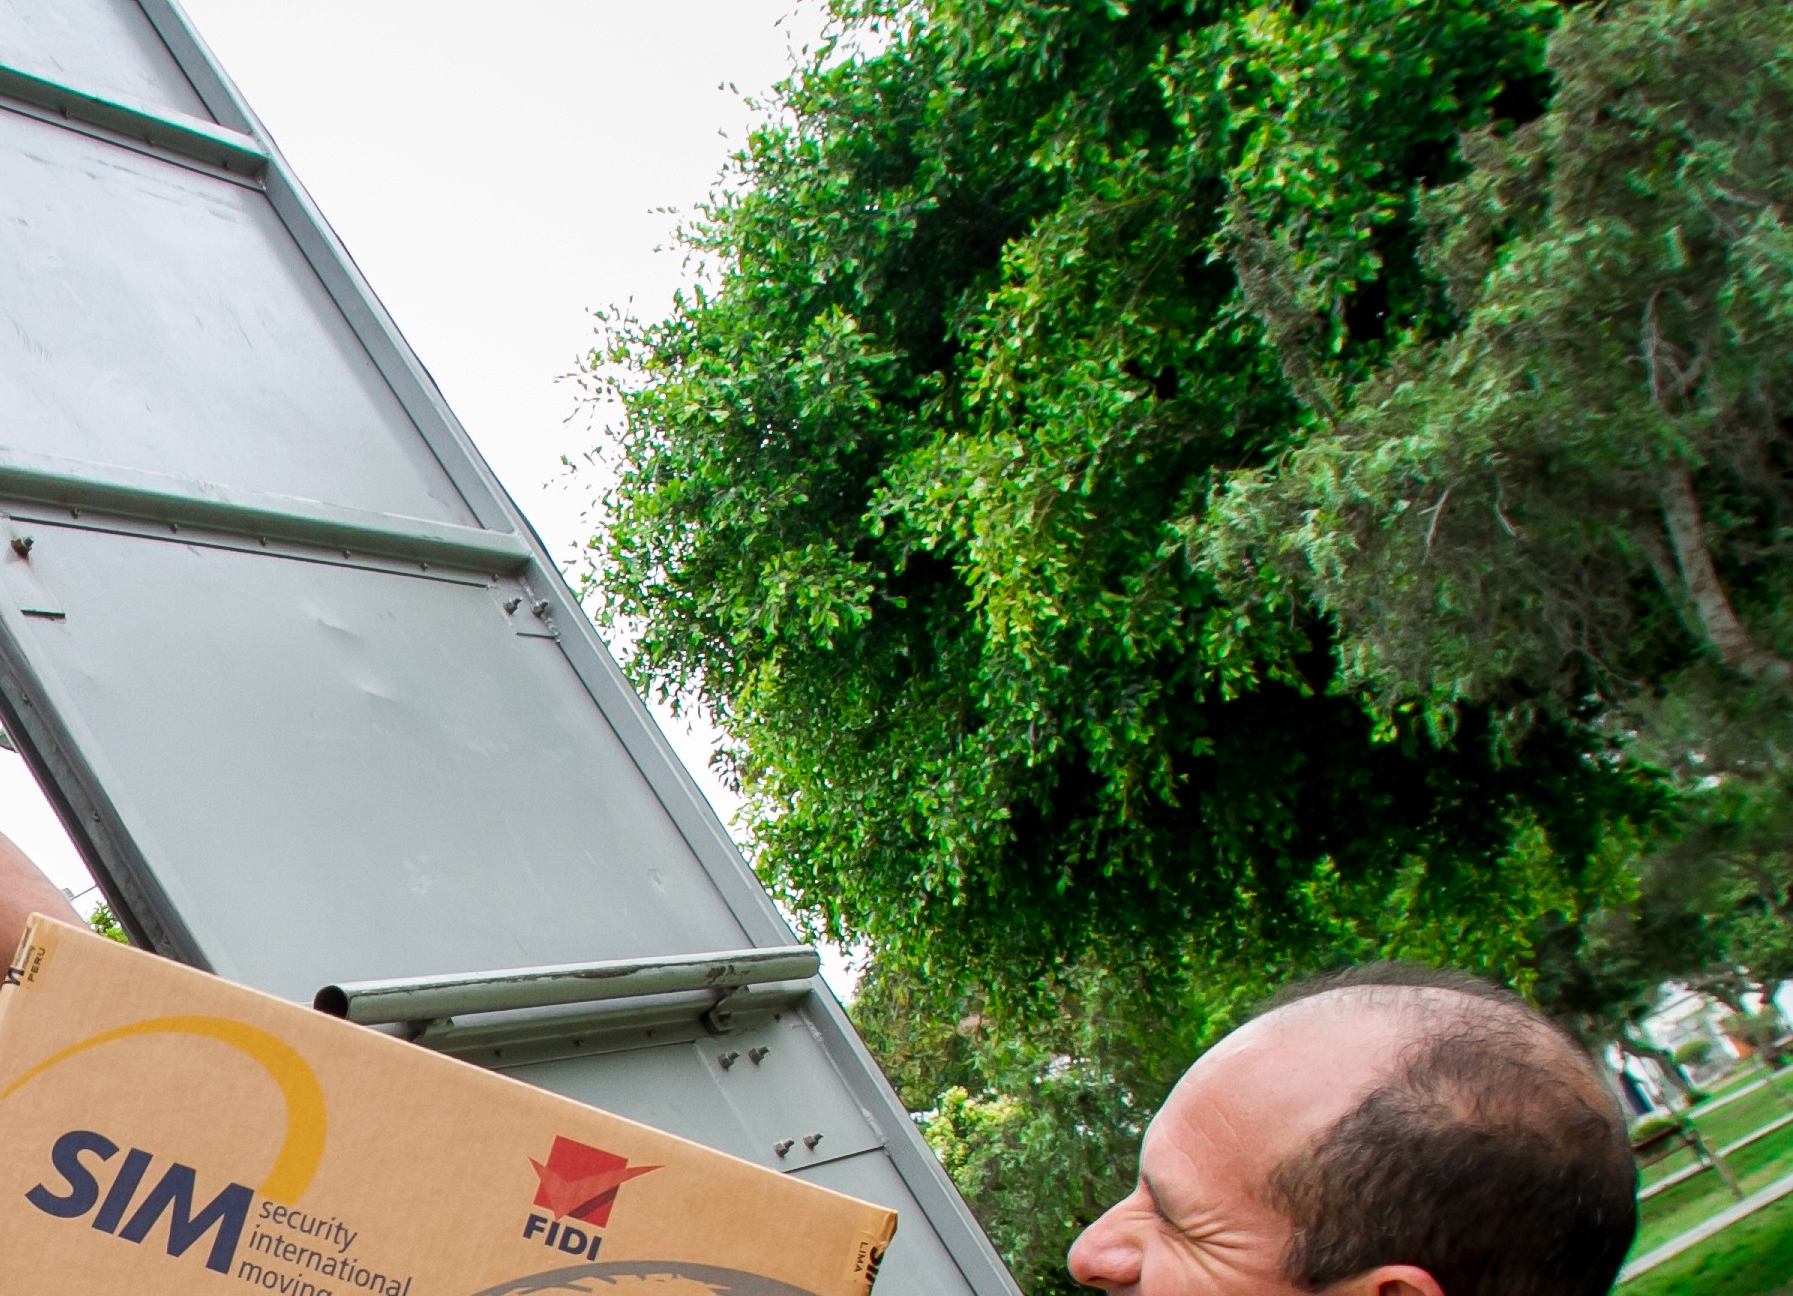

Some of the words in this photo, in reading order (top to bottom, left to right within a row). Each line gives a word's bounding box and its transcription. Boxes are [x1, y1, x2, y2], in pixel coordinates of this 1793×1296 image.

[27, 946, 46, 983] PERU
[24, 1129, 256, 1275] SIM
[258, 1199, 358, 1250] security
[522, 1214, 603, 1262] FIDI
